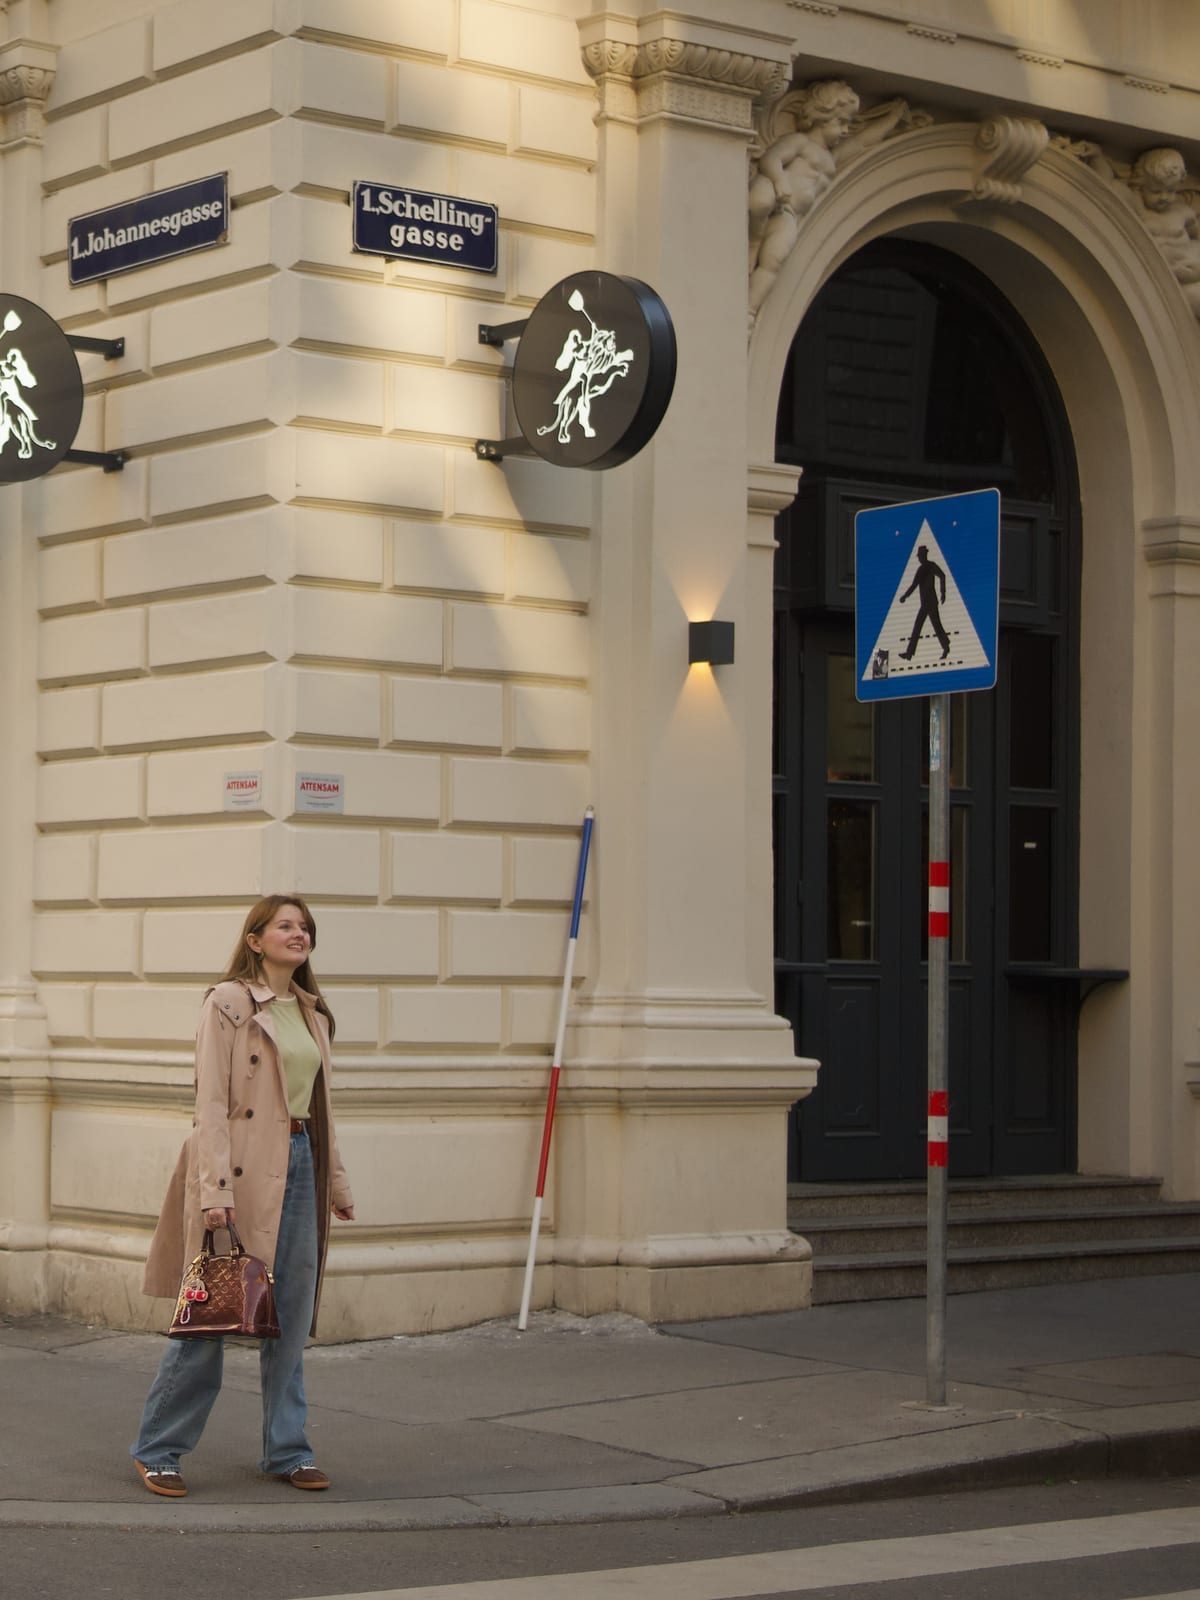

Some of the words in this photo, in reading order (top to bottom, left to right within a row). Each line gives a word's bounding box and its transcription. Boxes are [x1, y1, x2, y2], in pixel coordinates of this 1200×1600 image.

[390, 224, 465, 251] gasse
[227, 780, 257, 790] ATTENSAM
[300, 782, 339, 793] ATTENSAM
